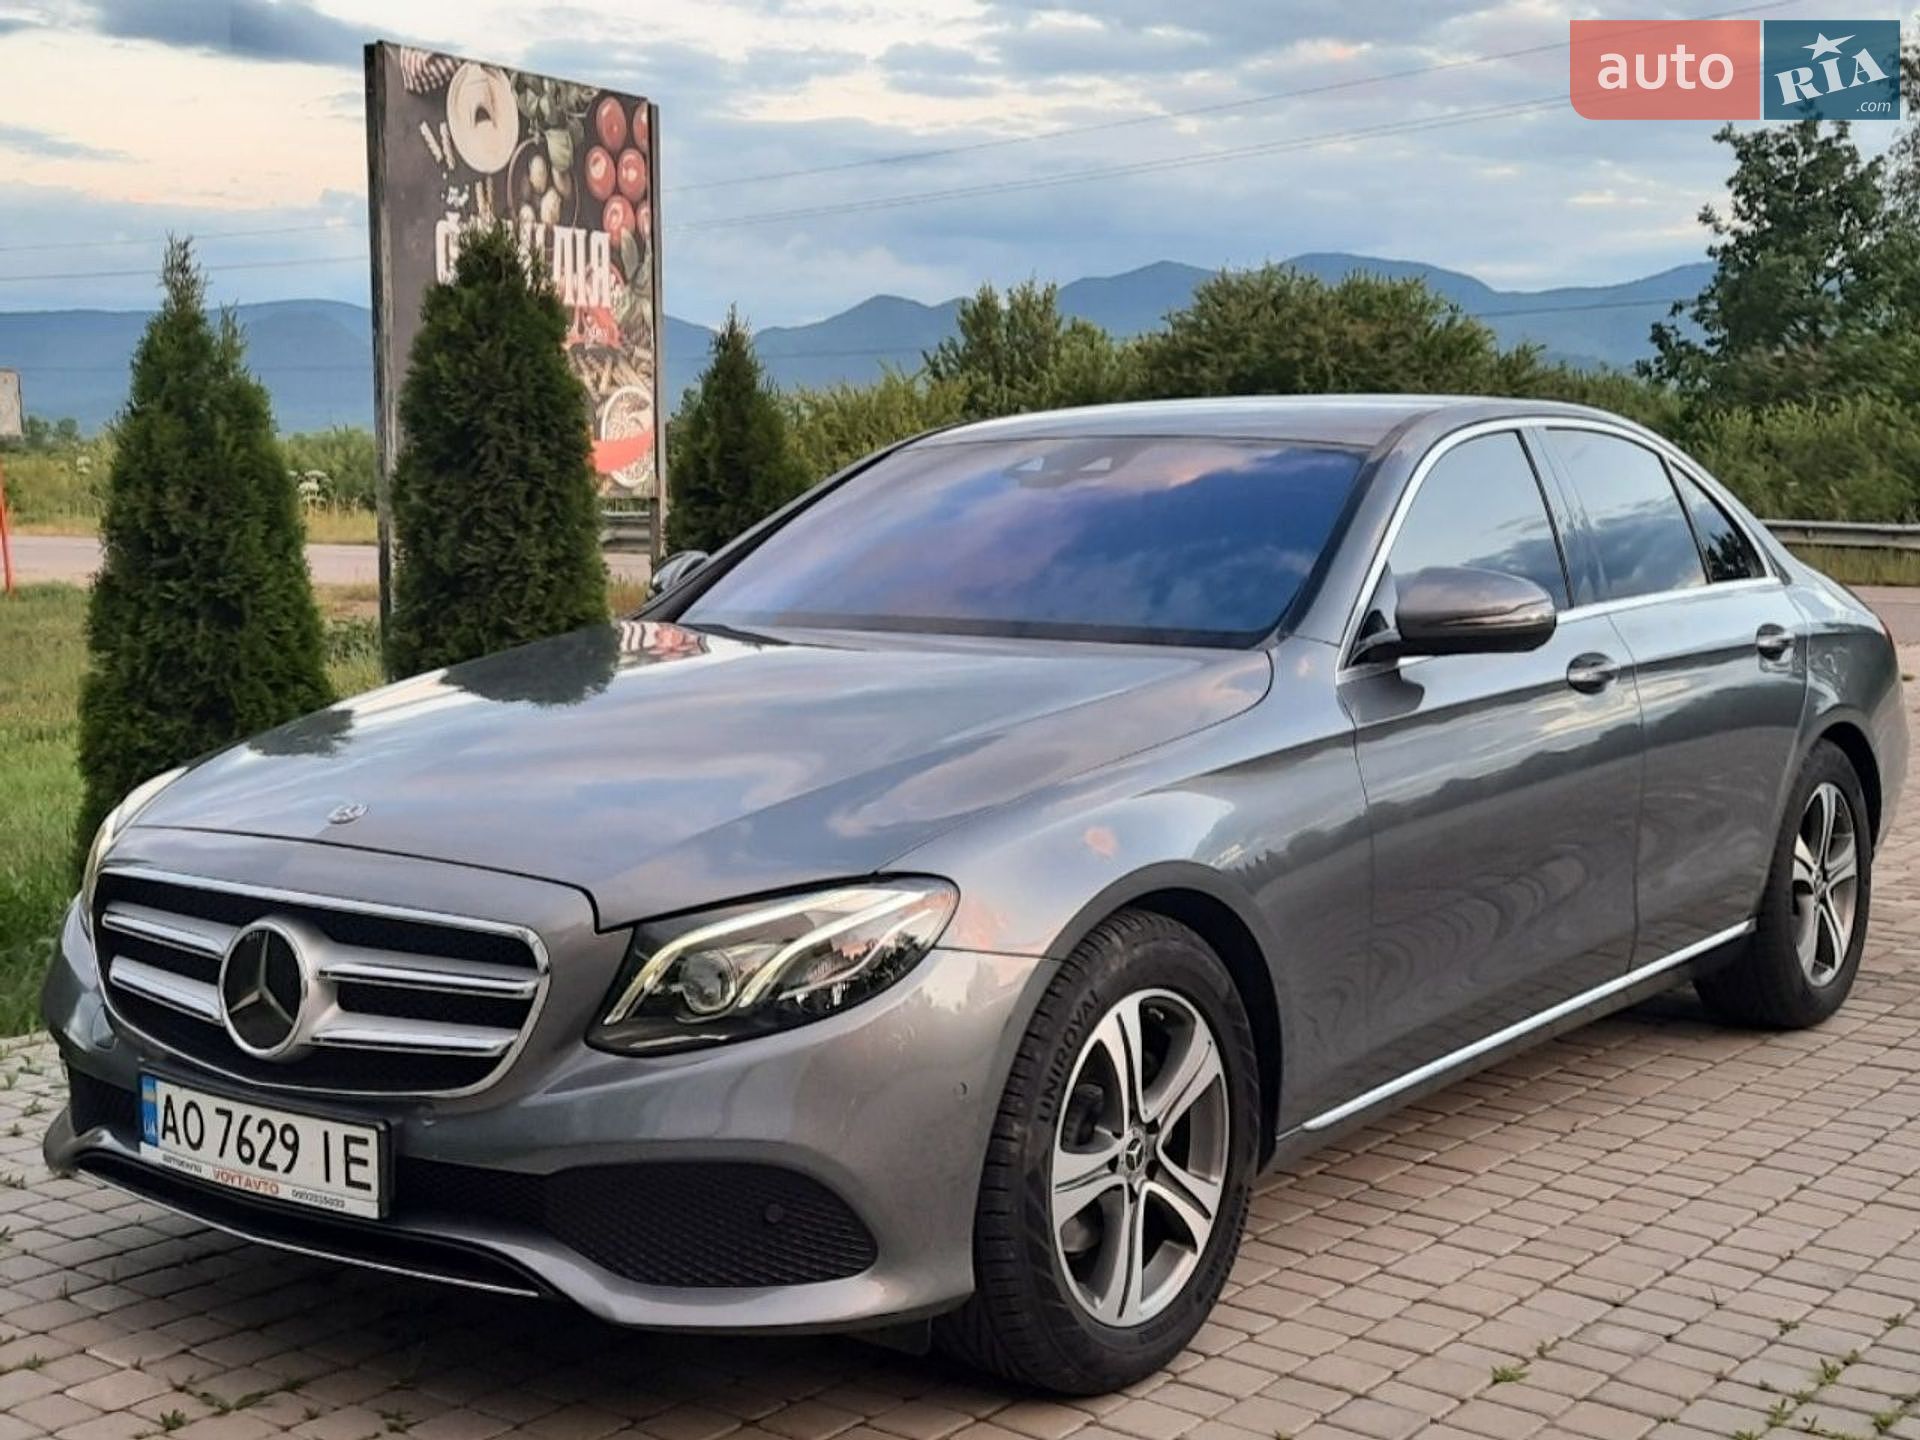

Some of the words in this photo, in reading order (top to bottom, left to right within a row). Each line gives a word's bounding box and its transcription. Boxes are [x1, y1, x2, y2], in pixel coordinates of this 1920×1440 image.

[1037, 988, 1102, 1123] UNIROYAL
[161, 1094, 204, 1151] AO
[215, 1107, 300, 1174] 7629
[323, 1131, 372, 1191] IE
